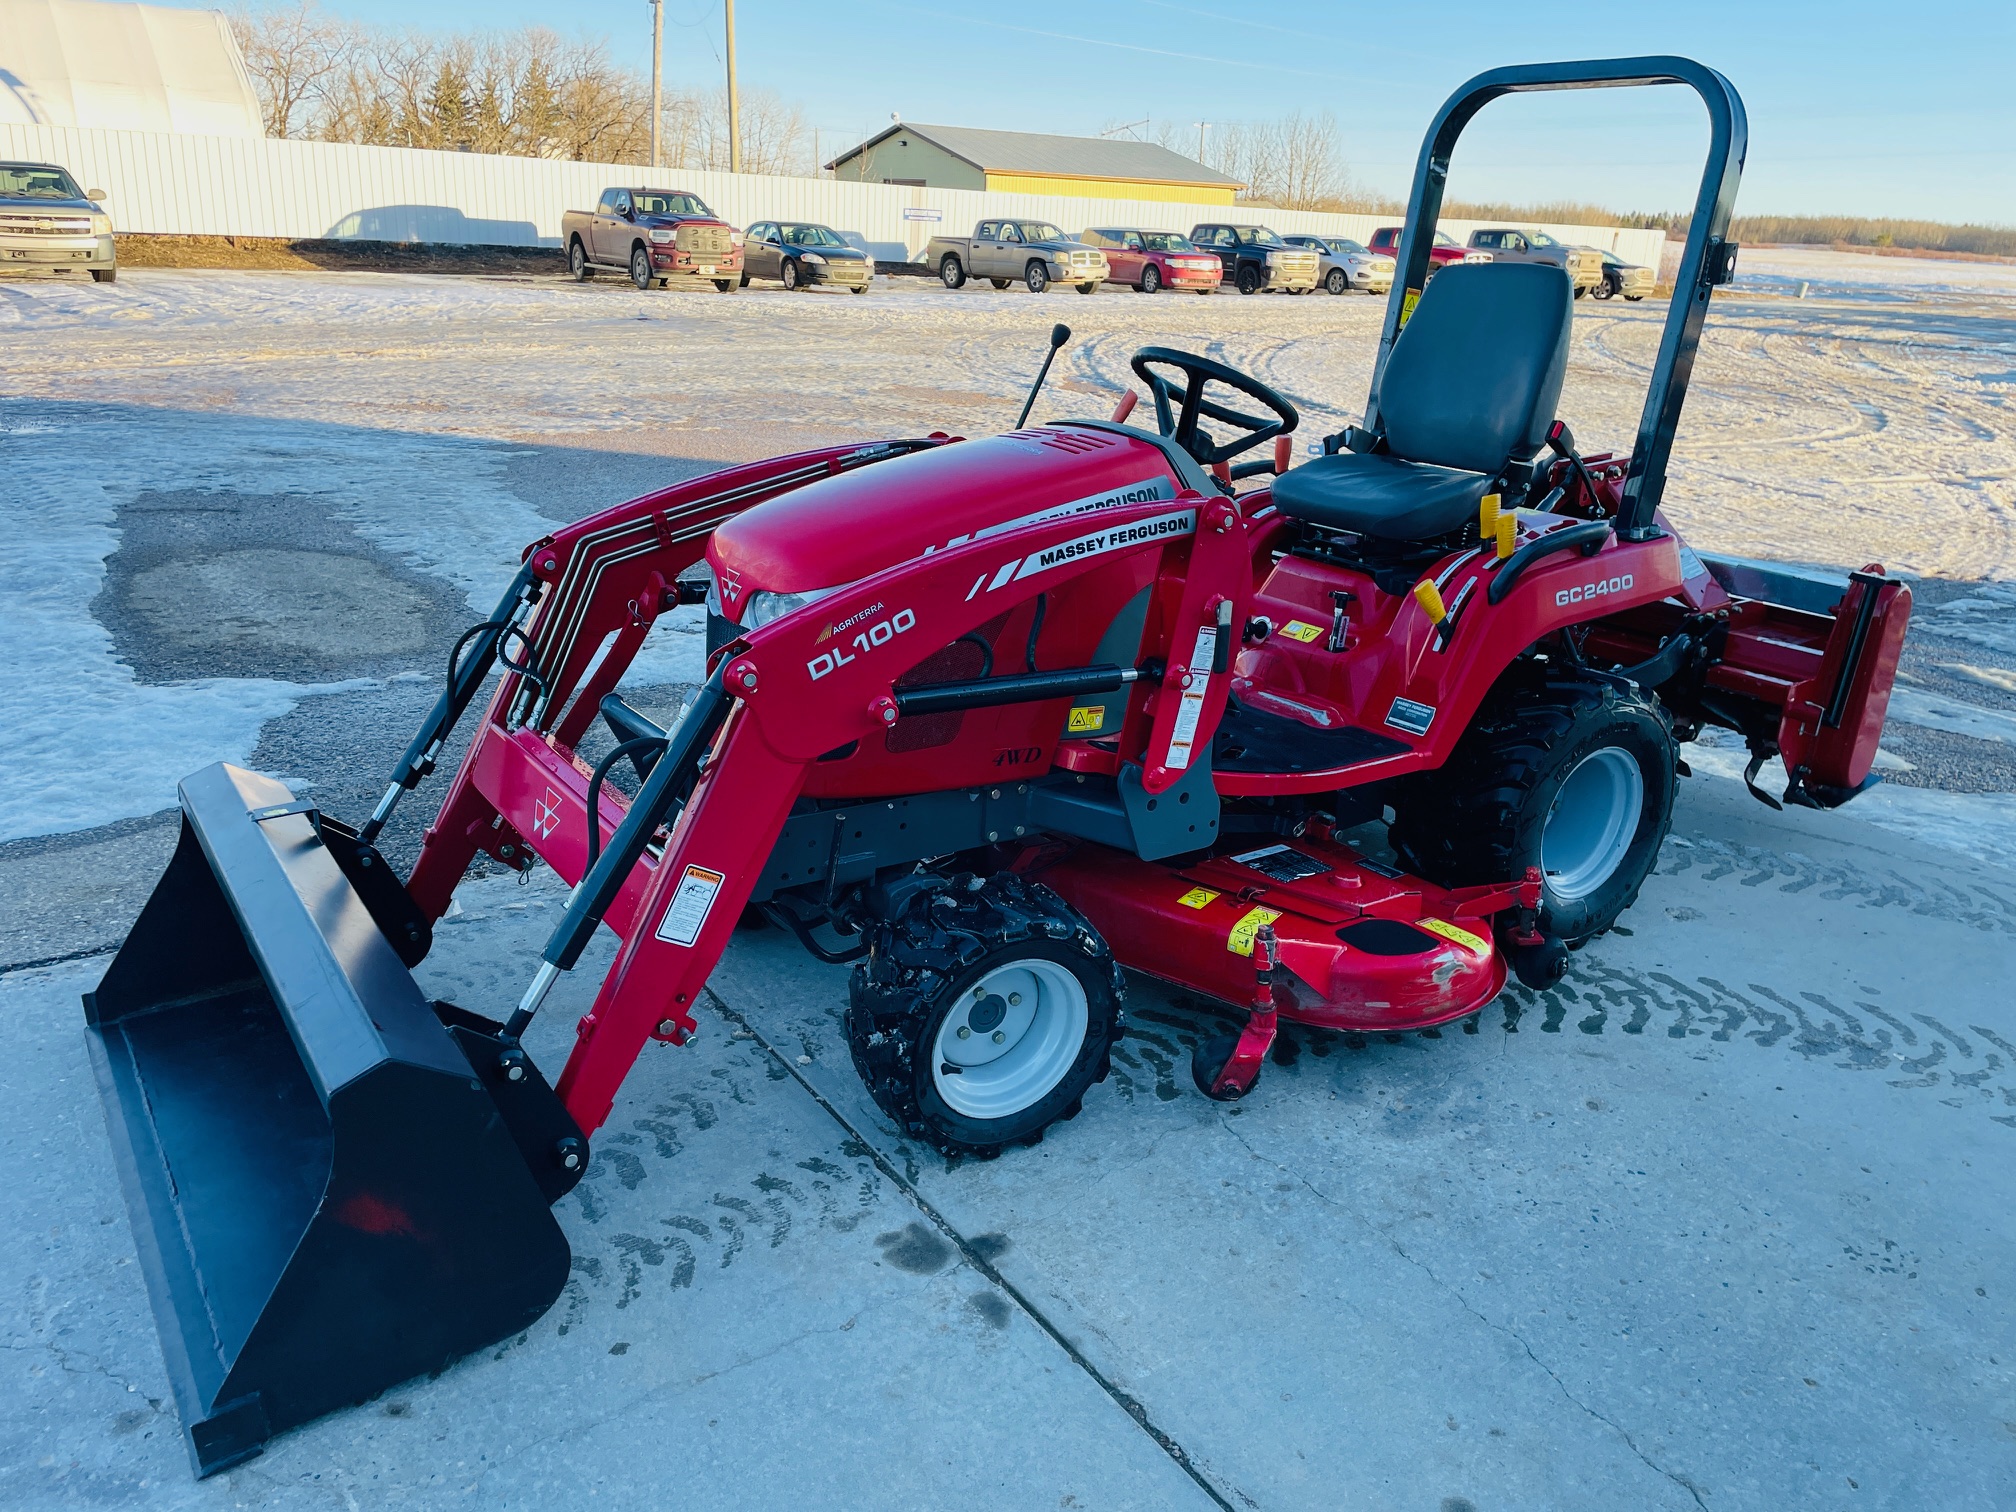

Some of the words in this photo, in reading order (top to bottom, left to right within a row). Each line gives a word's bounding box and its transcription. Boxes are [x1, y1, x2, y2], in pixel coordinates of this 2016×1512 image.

[1040, 537, 1105, 567] MASSEY
[1109, 517, 1189, 545] FERGUSON
[1555, 574, 1634, 606] GC2400
[833, 601, 884, 635] AGRITERRA
[992, 747, 1042, 766] 4WD
[695, 871, 719, 883] WARNING
